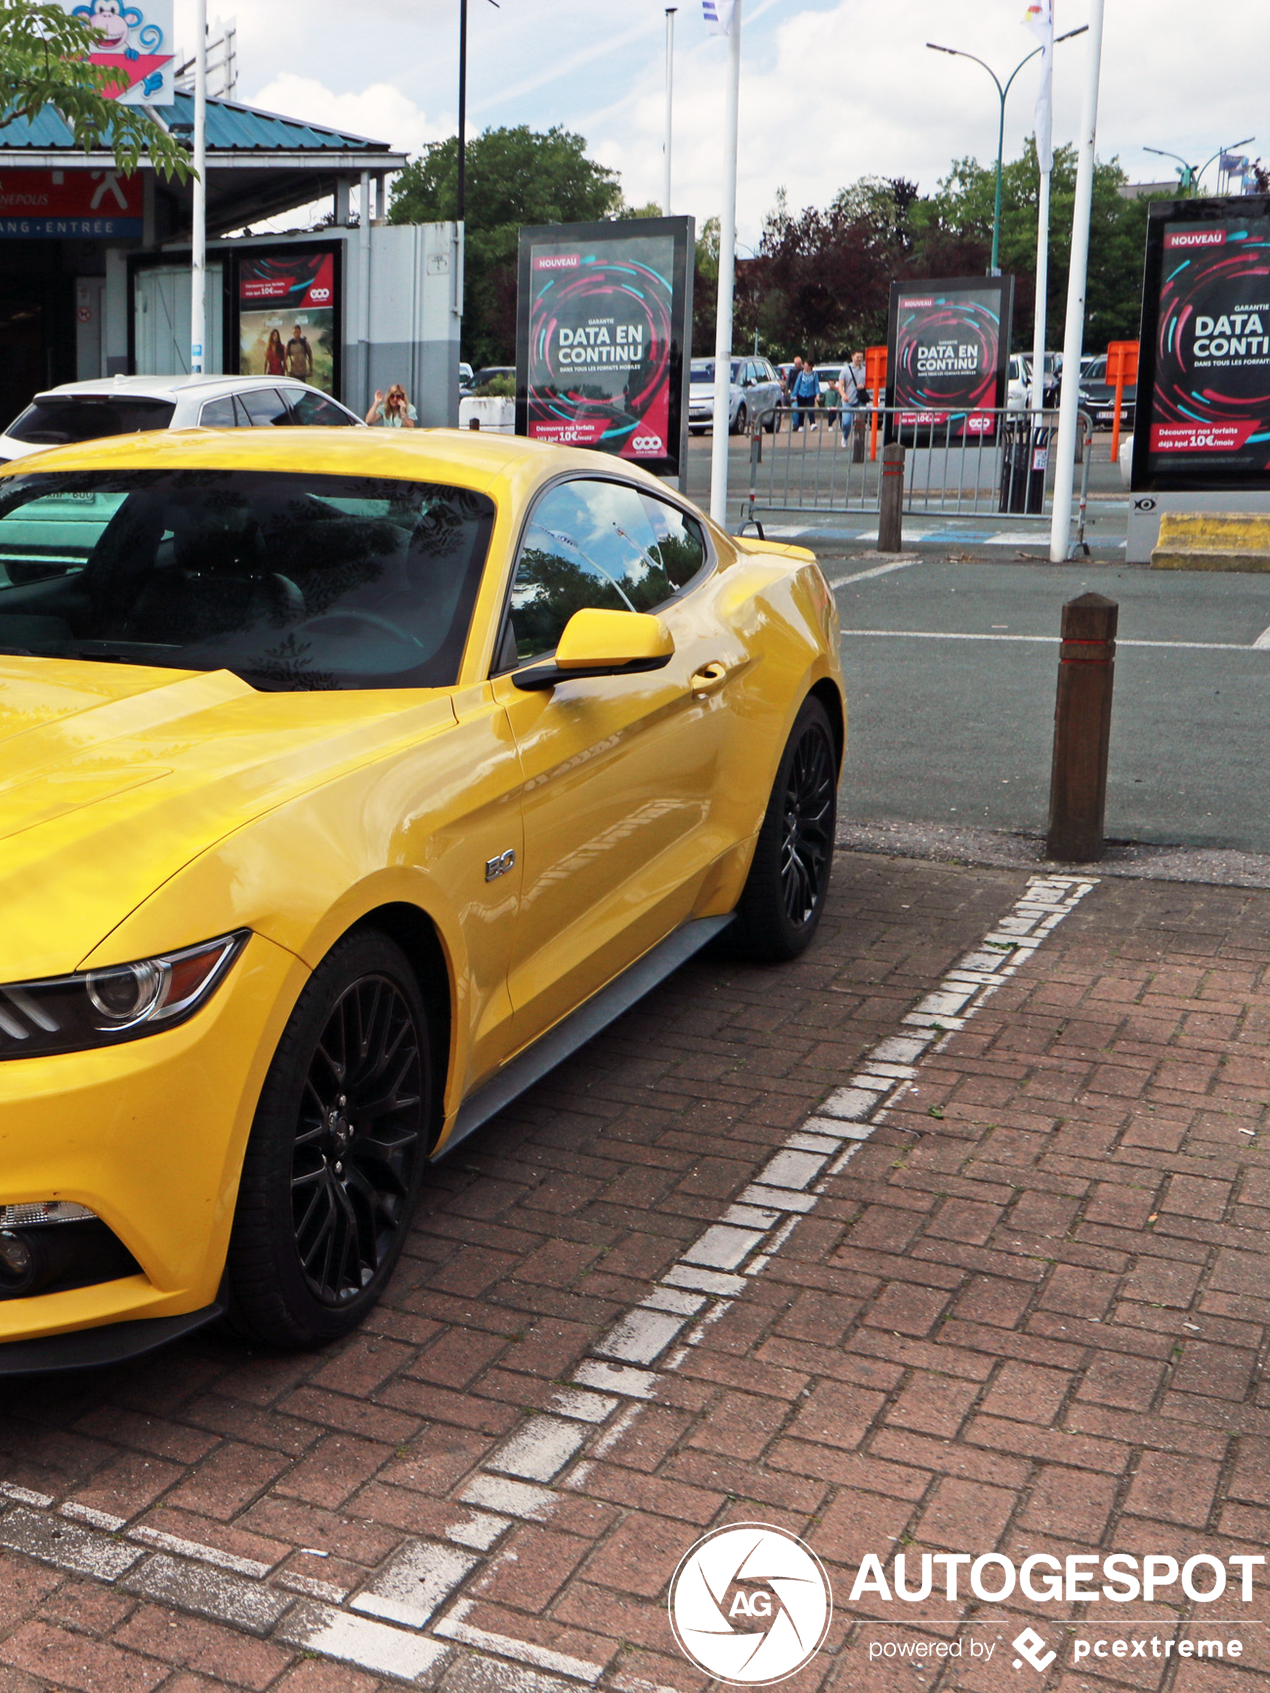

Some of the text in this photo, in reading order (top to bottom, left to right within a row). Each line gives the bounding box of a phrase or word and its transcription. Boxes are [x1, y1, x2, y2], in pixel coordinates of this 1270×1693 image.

[45, 219, 114, 233] ENTRÉE
[1171, 234, 1222, 246] NOUVEAU
[539, 258, 577, 268] NOUVEAU
[1234, 304, 1270, 312] GARANTIE
[1195, 314, 1264, 337] DATA
[559, 325, 643, 346] DATA EN
[558, 345, 643, 364] CONTINU
[918, 345, 978, 359] DATA EN
[917, 358, 978, 371] CONTINU
[1159, 428, 1196, 436] Découvrez
[1158, 440, 1173, 448] déjà
[485, 848, 516, 883] 5.0
